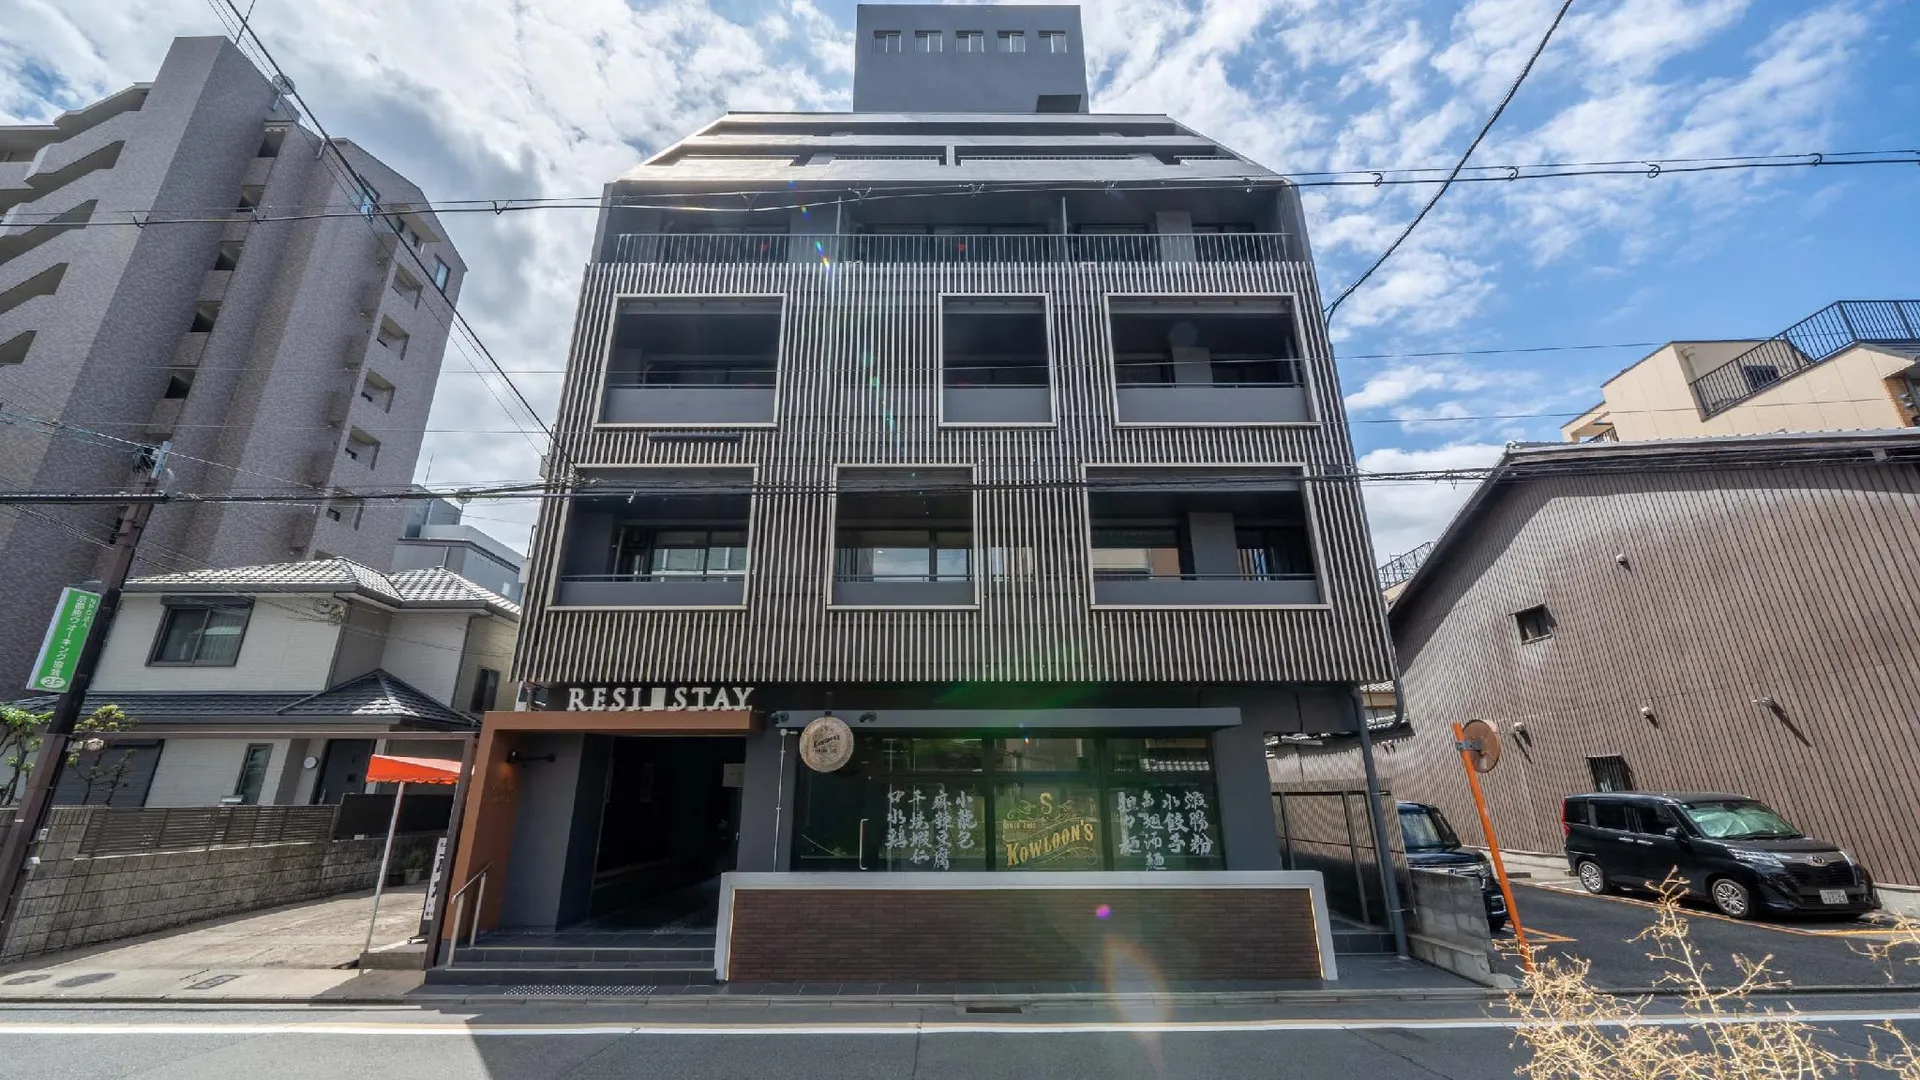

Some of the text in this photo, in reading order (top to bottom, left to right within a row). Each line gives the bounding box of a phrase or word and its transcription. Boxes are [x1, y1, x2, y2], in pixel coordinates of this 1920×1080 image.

[43, 678, 63, 687] 2F
[567, 687, 754, 712] RESI STAY
[1039, 792, 1053, 815] S
[1161, 793, 1190, 853] 水餃子
